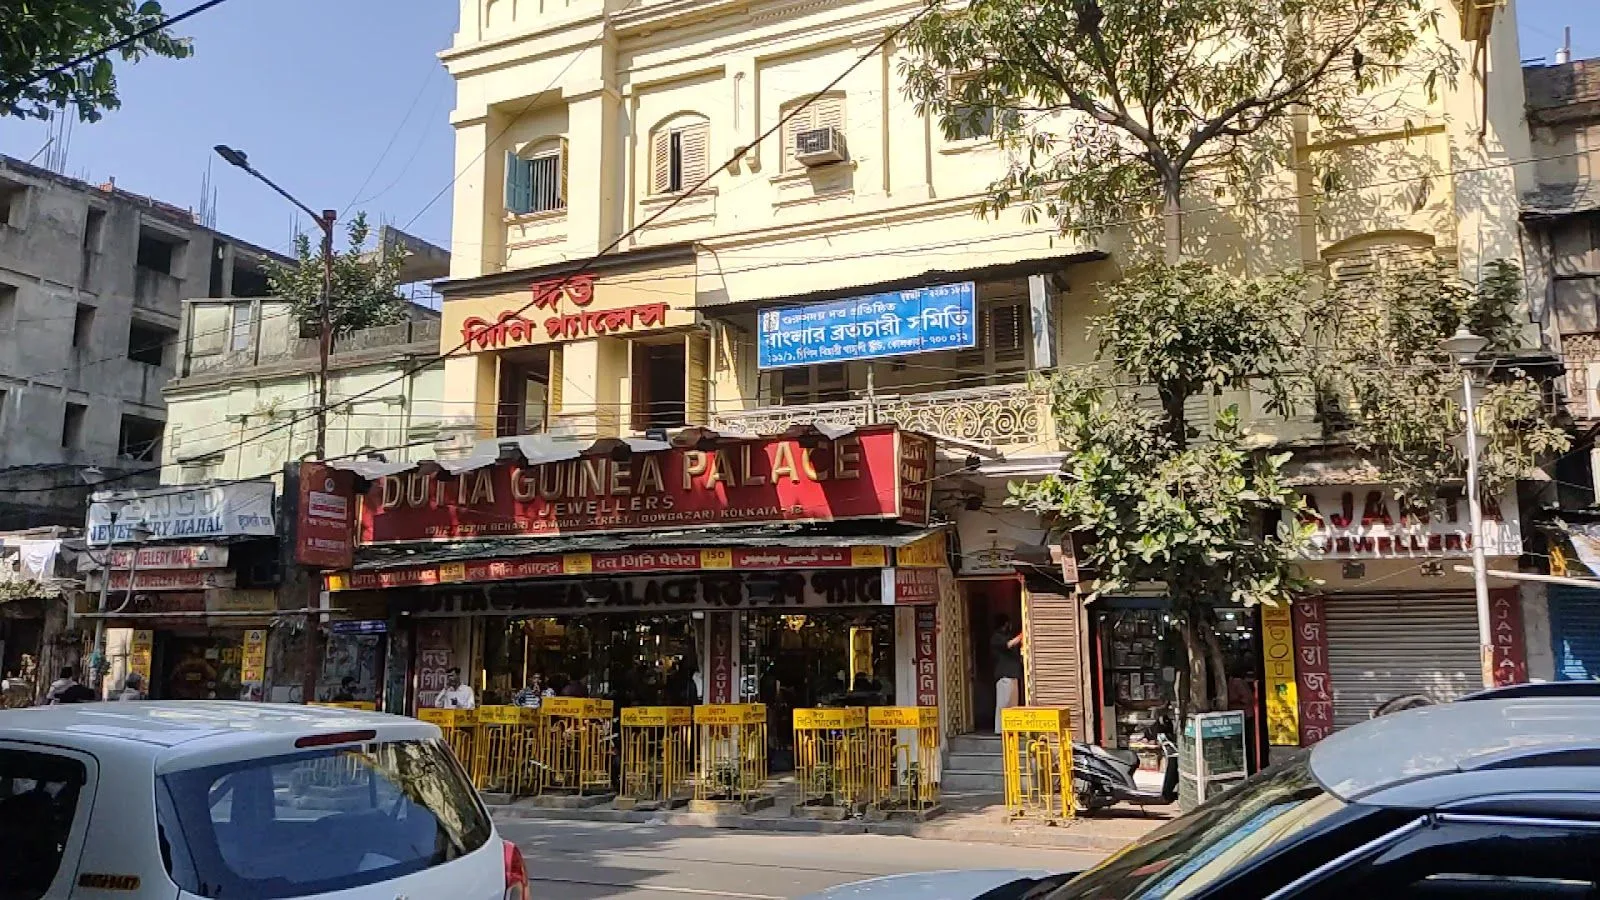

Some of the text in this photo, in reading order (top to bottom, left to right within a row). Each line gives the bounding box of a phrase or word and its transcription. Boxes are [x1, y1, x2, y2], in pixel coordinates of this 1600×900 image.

[532, 273, 600, 313] দত্ত
[461, 302, 670, 350] গিনি প্যালেস
[763, 305, 970, 348] বাংলার ব্রতচারী সমিতি
[511, 455, 665, 501] GUINEA
[682, 435, 860, 490] PALACE
[539, 494, 674, 516] JEWELLERS
[720, 506, 778, 519] KOLKATA
[90, 516, 224, 541] JEWELRY MAHAL
[1495, 597, 1515, 668] AJANTA
